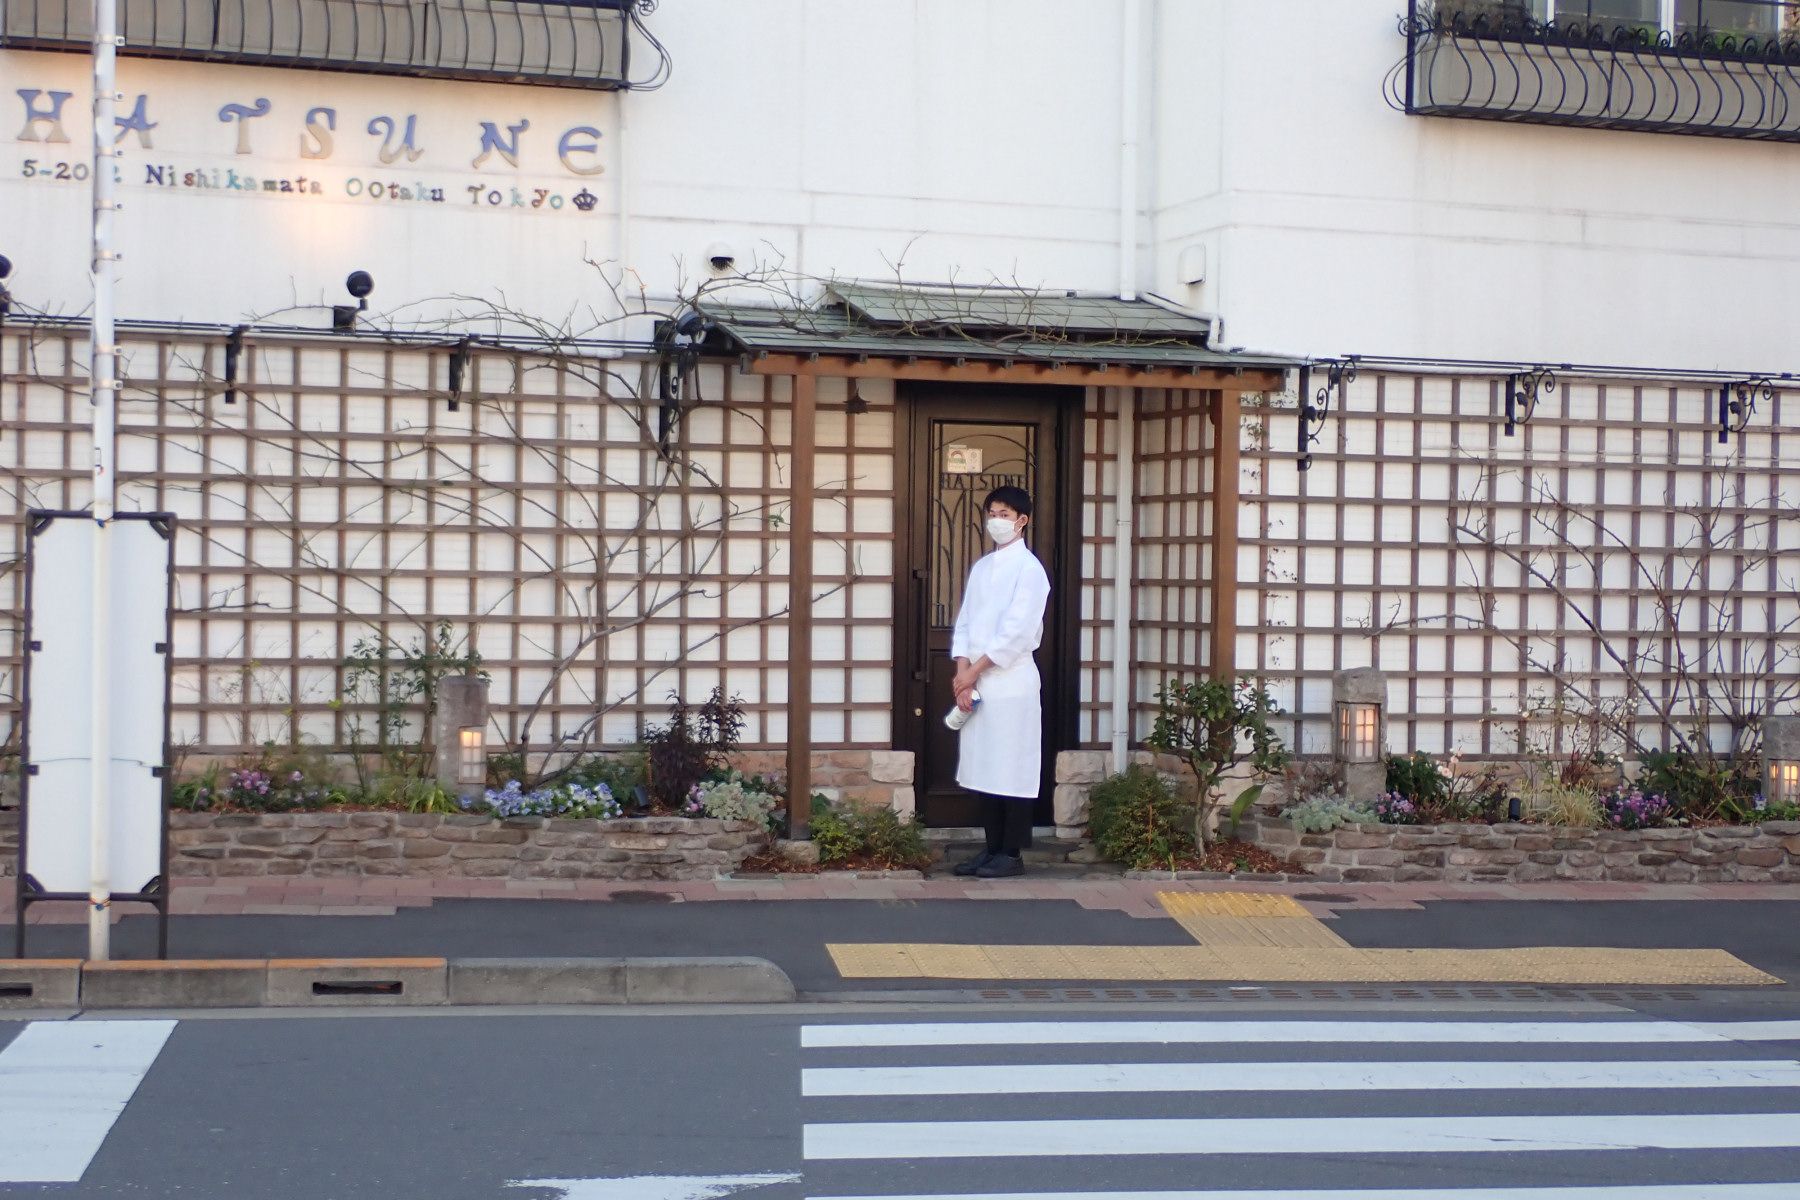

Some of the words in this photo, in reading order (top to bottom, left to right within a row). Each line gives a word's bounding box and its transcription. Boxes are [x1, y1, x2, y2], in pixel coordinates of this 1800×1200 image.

[16, 88, 605, 176] HATSUNE
[145, 164, 323, 195] Nishikamata
[467, 183, 564, 210] Tokyo
